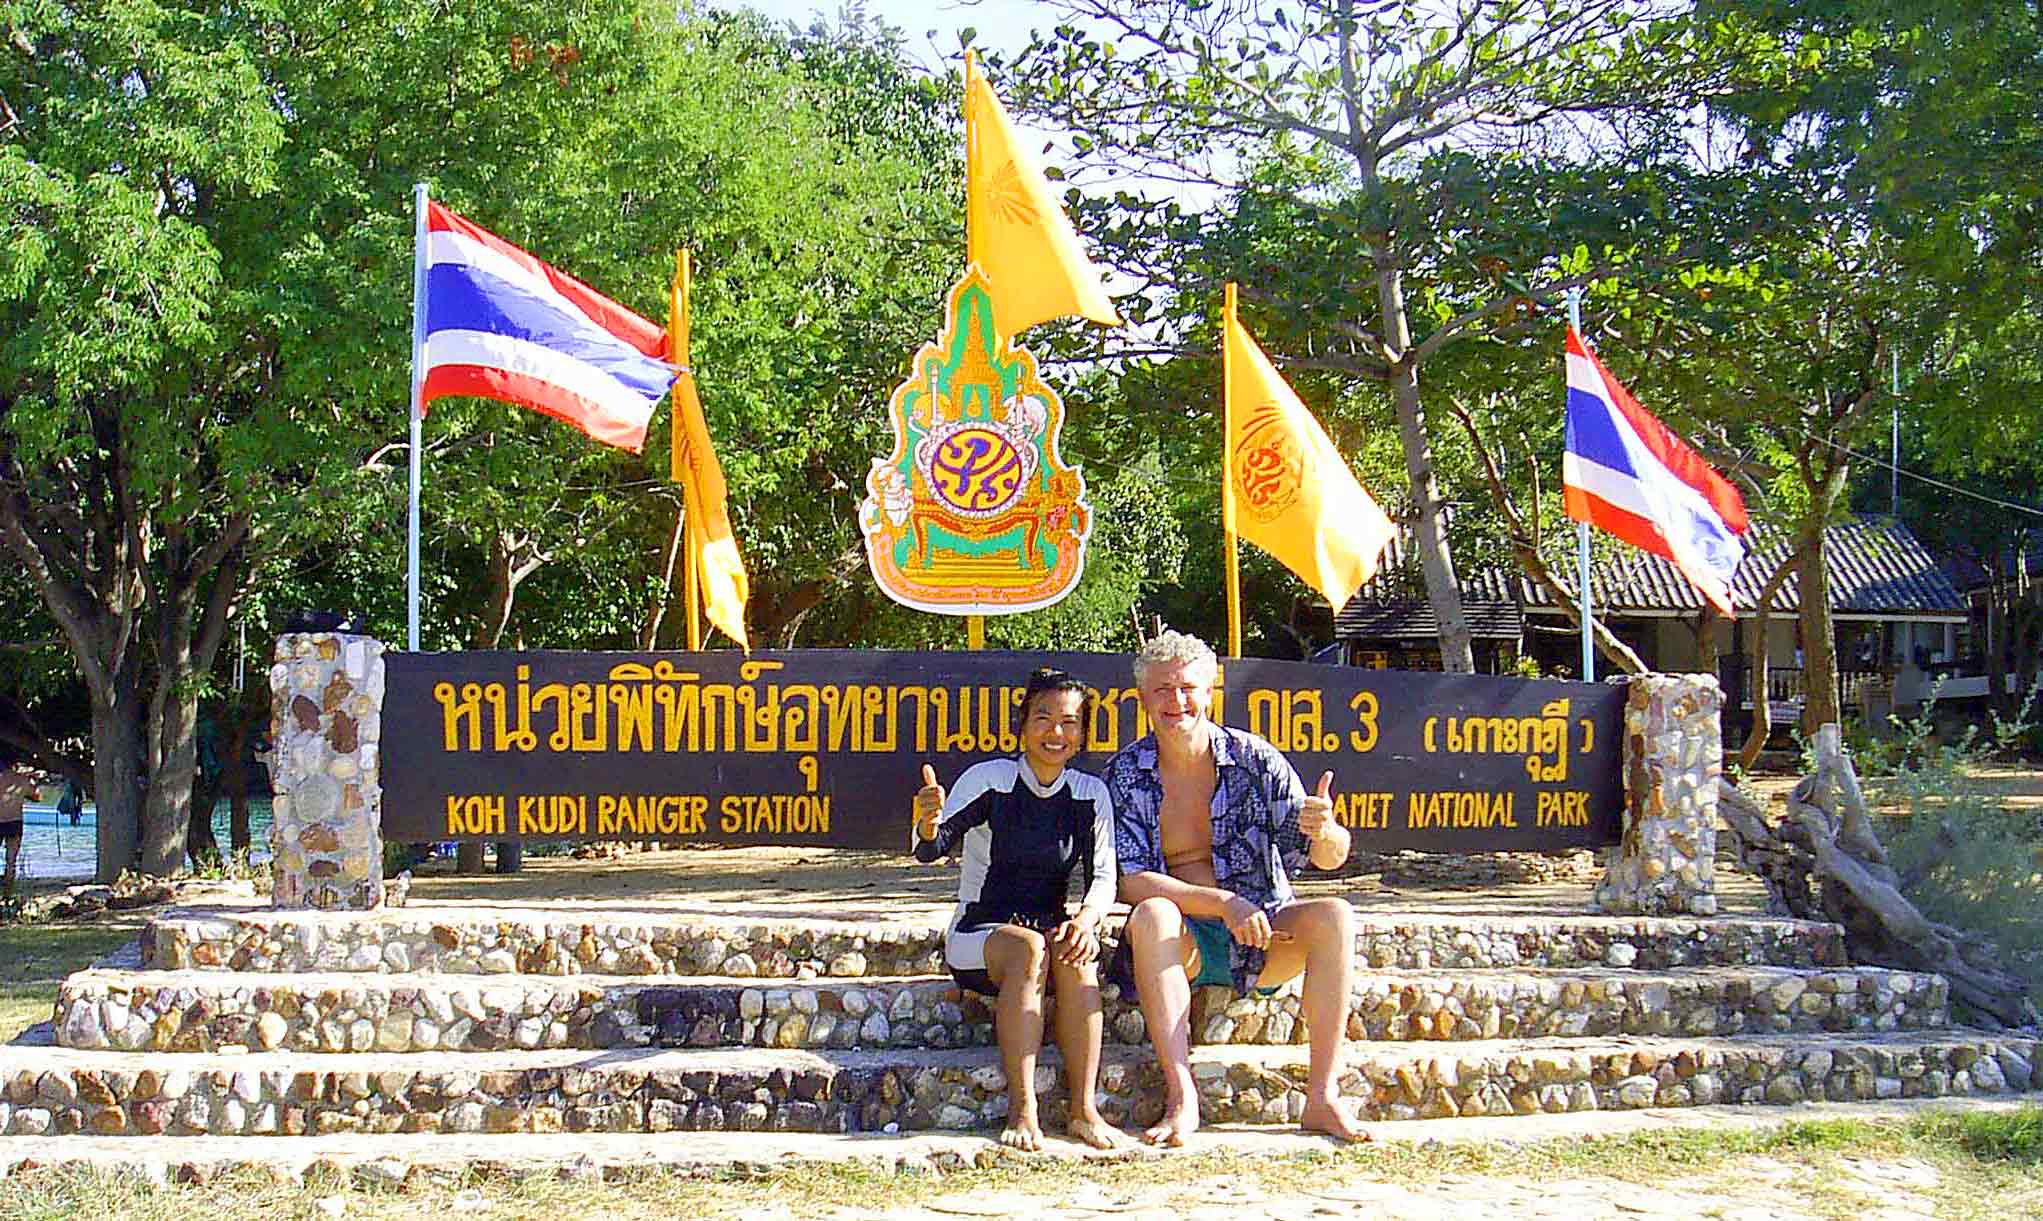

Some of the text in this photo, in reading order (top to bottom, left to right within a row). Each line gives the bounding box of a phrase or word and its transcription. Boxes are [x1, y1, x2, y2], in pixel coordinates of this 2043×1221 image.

[1349, 690, 1379, 753] 3
[447, 795, 830, 835] KOH KUDI RANGER STATION
[1332, 790, 1591, 829] AMET NATIONAL PARK
